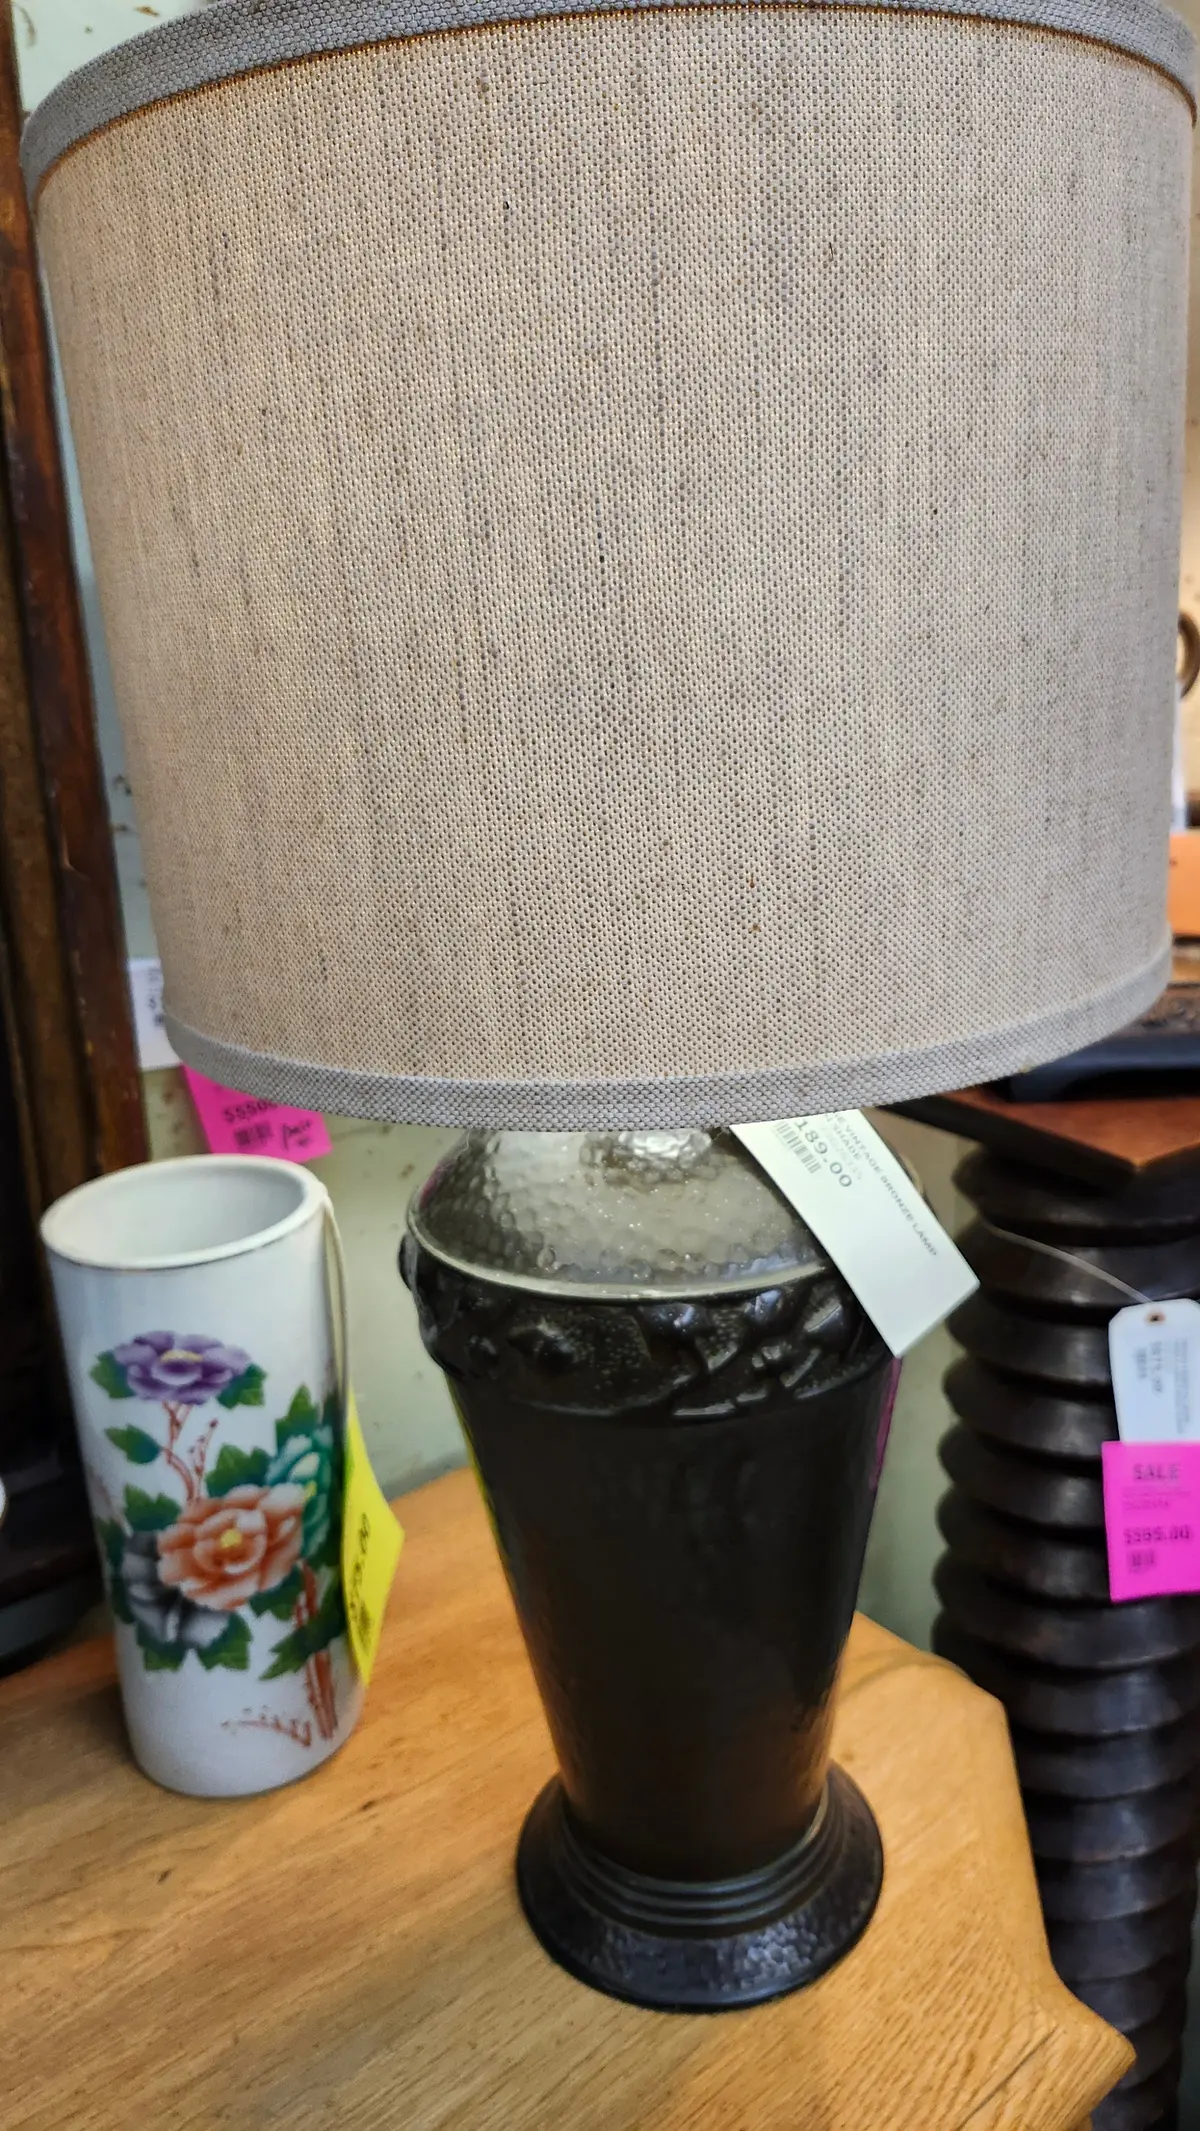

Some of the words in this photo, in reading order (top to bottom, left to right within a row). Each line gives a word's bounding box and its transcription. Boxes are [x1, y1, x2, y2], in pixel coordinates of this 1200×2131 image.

[832, 1123, 862, 1160] SHADE
[845, 1124, 881, 1174] VINTAGE
[880, 1175, 915, 1221] BRONZE
[912, 1222, 938, 1256] LAMP
[1133, 1463, 1179, 1481] SALE
